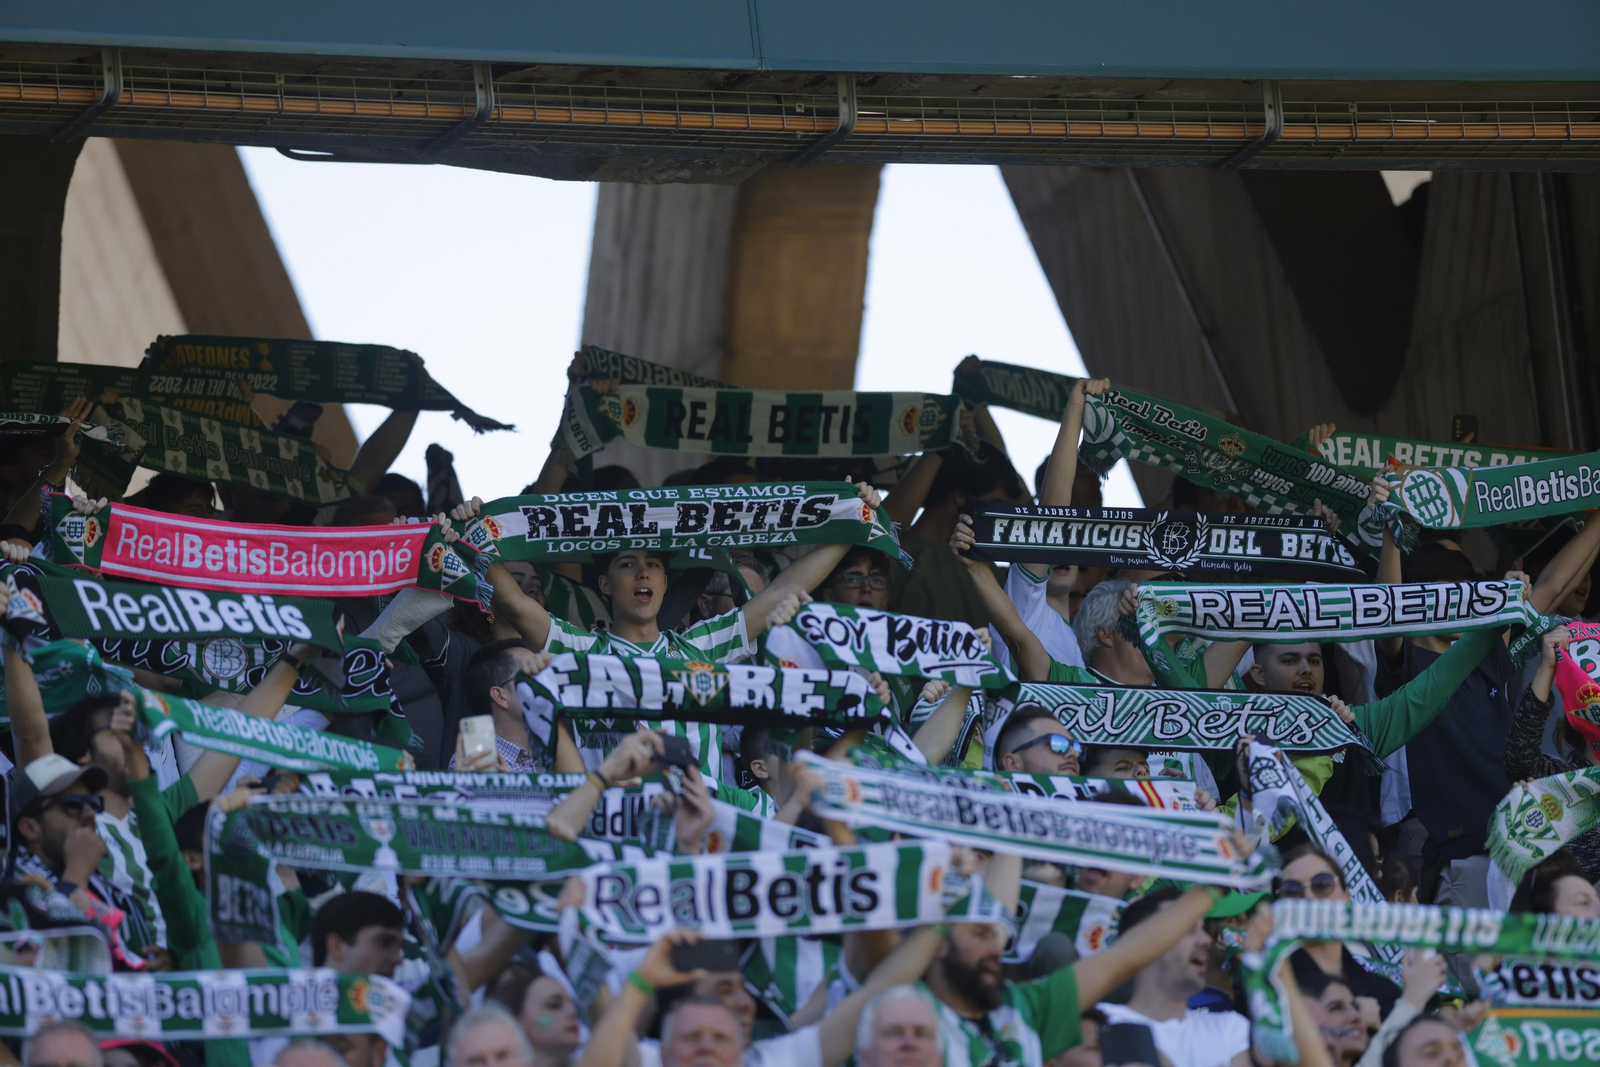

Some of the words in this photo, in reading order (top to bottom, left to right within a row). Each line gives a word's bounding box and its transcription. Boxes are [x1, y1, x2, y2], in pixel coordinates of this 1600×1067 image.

[171, 344, 250, 369] MPEONES
[148, 375, 183, 394] 2022
[182, 377, 205, 396] REY
[663, 400, 753, 443] REAL
[767, 403, 873, 444] BETIS
[1102, 389, 1150, 419] Real
[1151, 404, 1208, 441] Betis
[126, 418, 158, 446] eal
[164, 424, 221, 461] Betis
[570, 422, 593, 452] BETIS
[1318, 437, 1386, 468] REAL
[1394, 442, 1483, 468] BETIS
[542, 490, 617, 504] DICEN
[628, 487, 681, 501] QUE
[687, 484, 807, 499] ESTAMOS
[1249, 467, 1295, 496] tuyos
[1305, 461, 1336, 486] 100
[1331, 474, 1372, 499] años
[520, 502, 658, 541] REAL
[673, 495, 838, 535] BETIS
[1037, 508, 1078, 517] PADRES
[1086, 509, 1092, 518] A
[1102, 510, 1134, 520] HIJOS
[1222, 515, 1236, 524] DE
[1243, 517, 1291, 526] ABUELOS
[1298, 519, 1304, 527] A
[116, 522, 413, 585] RealBetisBalompié
[546, 539, 622, 553] LOCOS
[629, 537, 662, 549] DE
[669, 536, 698, 548] LA
[706, 531, 798, 547] CABEZA
[992, 518, 1144, 549] FANATICOS
[1208, 528, 1263, 556] DEL
[1280, 532, 1356, 567] BETIS
[1109, 554, 1126, 564] Una
[1200, 559, 1231, 570] llamada
[1233, 560, 1253, 572] Betis
[73, 578, 313, 641] RealBetis
[1189, 588, 1340, 631] REAL
[1350, 581, 1509, 627] BETIS
[799, 612, 868, 650] SOY
[866, 614, 988, 662] Bético
[1510, 633, 1535, 657] REAL
[531, 651, 686, 711] EAL
[1016, 691, 1138, 736] al
[1143, 697, 1333, 746] Betis
[405, 771, 533, 788] VILLAMARÍN
[537, 773, 588, 787] NITO
[597, 861, 880, 928] RealBetis
[1502, 964, 1600, 1001] etis
